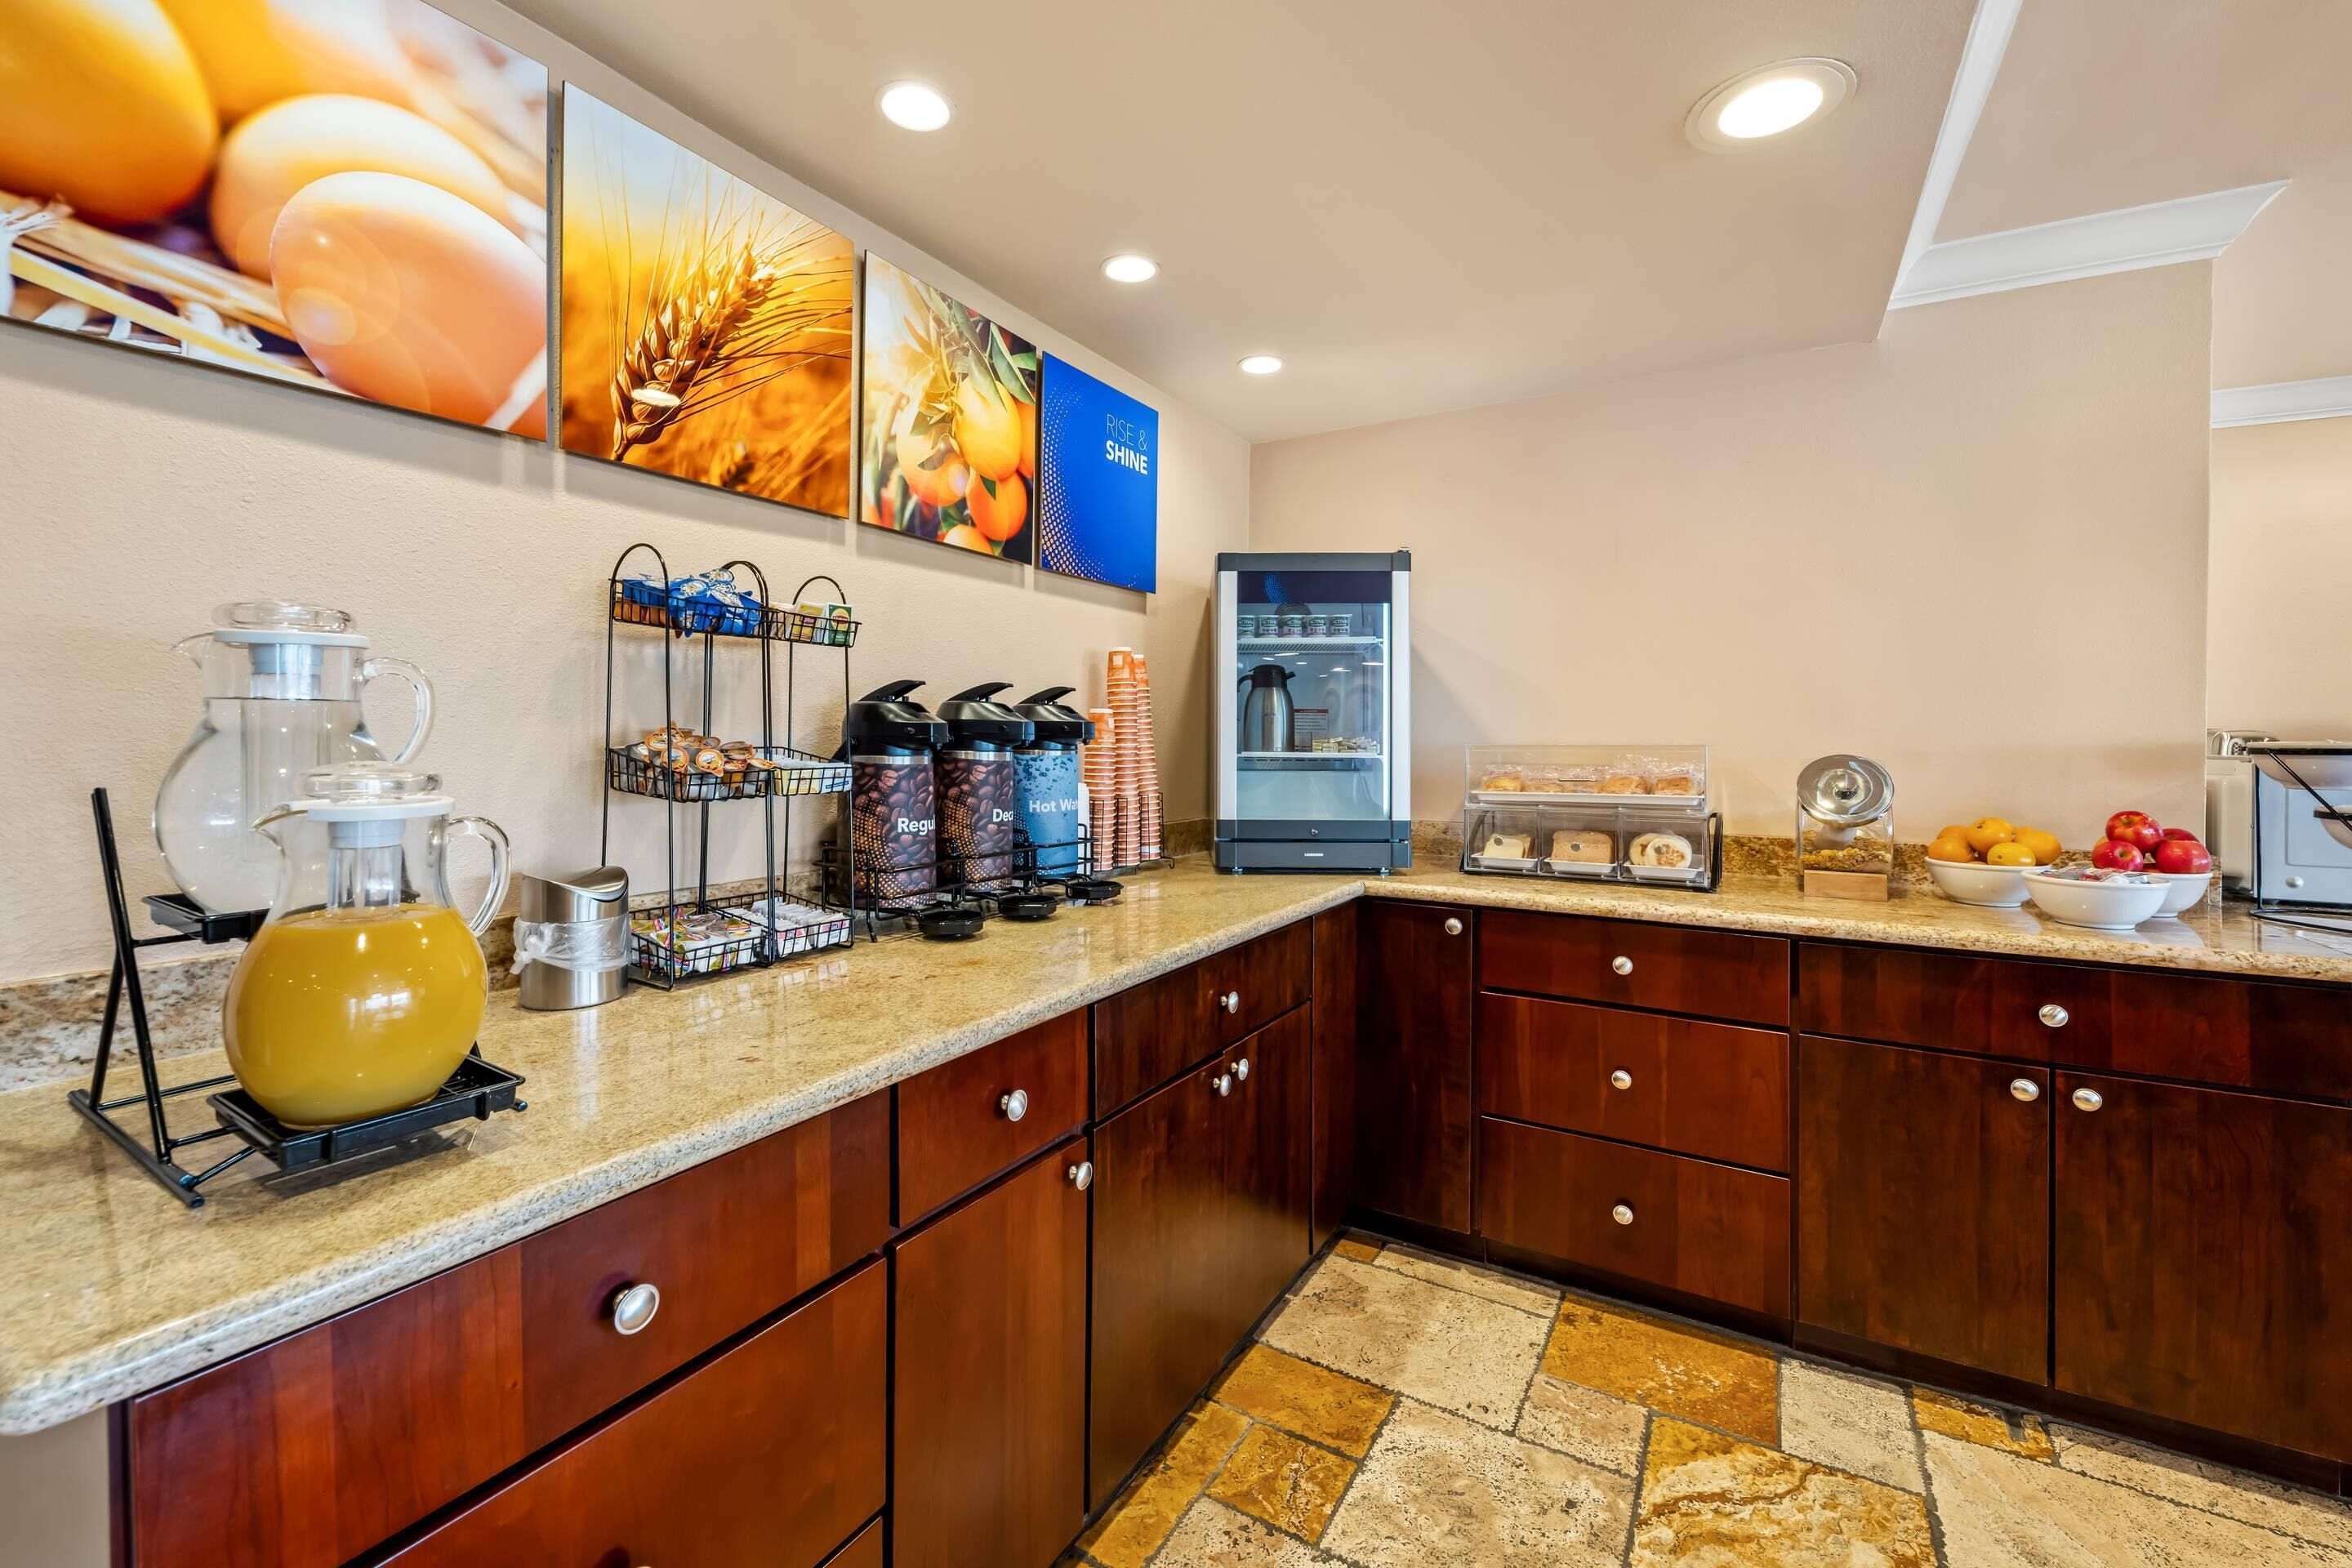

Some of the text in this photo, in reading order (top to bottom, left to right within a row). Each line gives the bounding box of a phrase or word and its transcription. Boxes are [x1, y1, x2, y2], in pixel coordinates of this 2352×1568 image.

[1107, 414, 1147, 452] RISE &
[1106, 440, 1147, 475] SHINE
[1029, 800, 1057, 813] Hot
